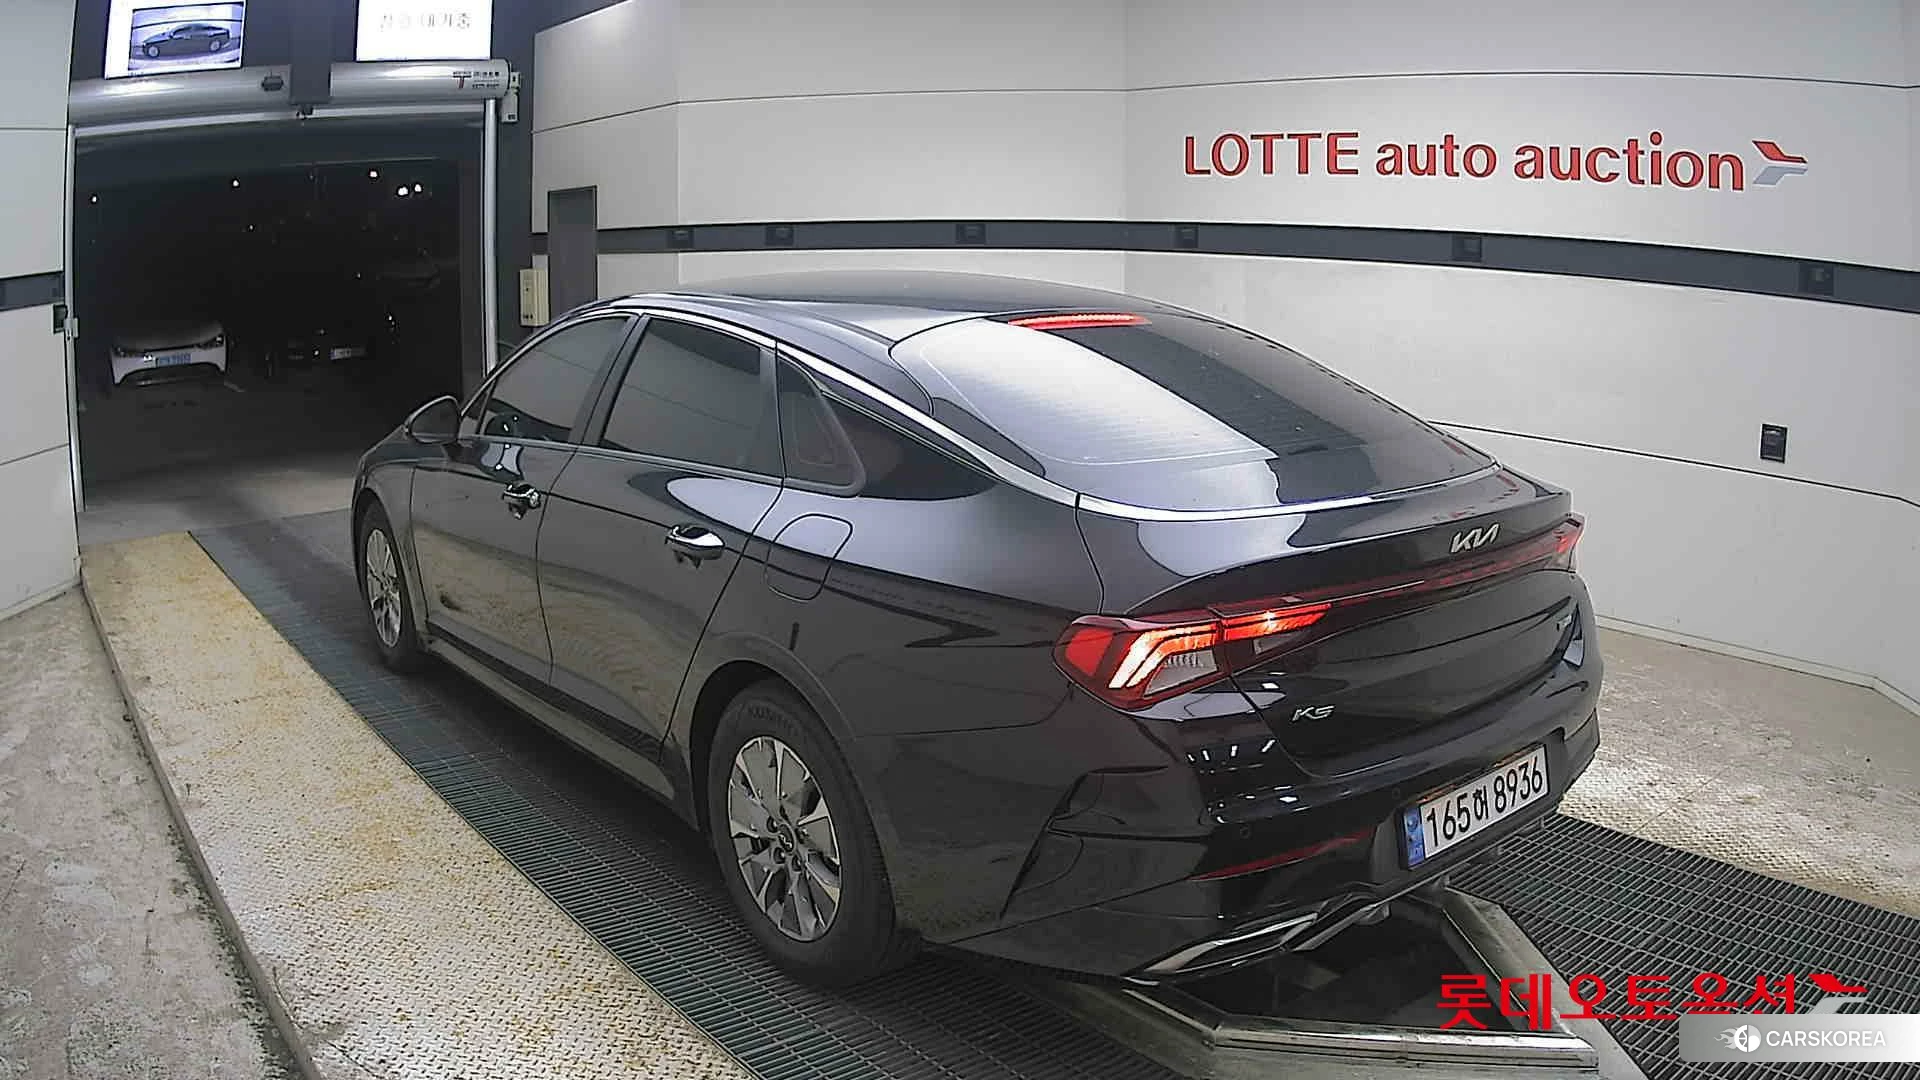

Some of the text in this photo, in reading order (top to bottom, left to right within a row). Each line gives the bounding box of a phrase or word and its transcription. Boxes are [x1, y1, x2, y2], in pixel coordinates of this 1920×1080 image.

[1184, 131, 1745, 192] LOTTE auto auction
[1292, 705, 1335, 721] K5
[1426, 756, 1543, 847] 165허 8936
